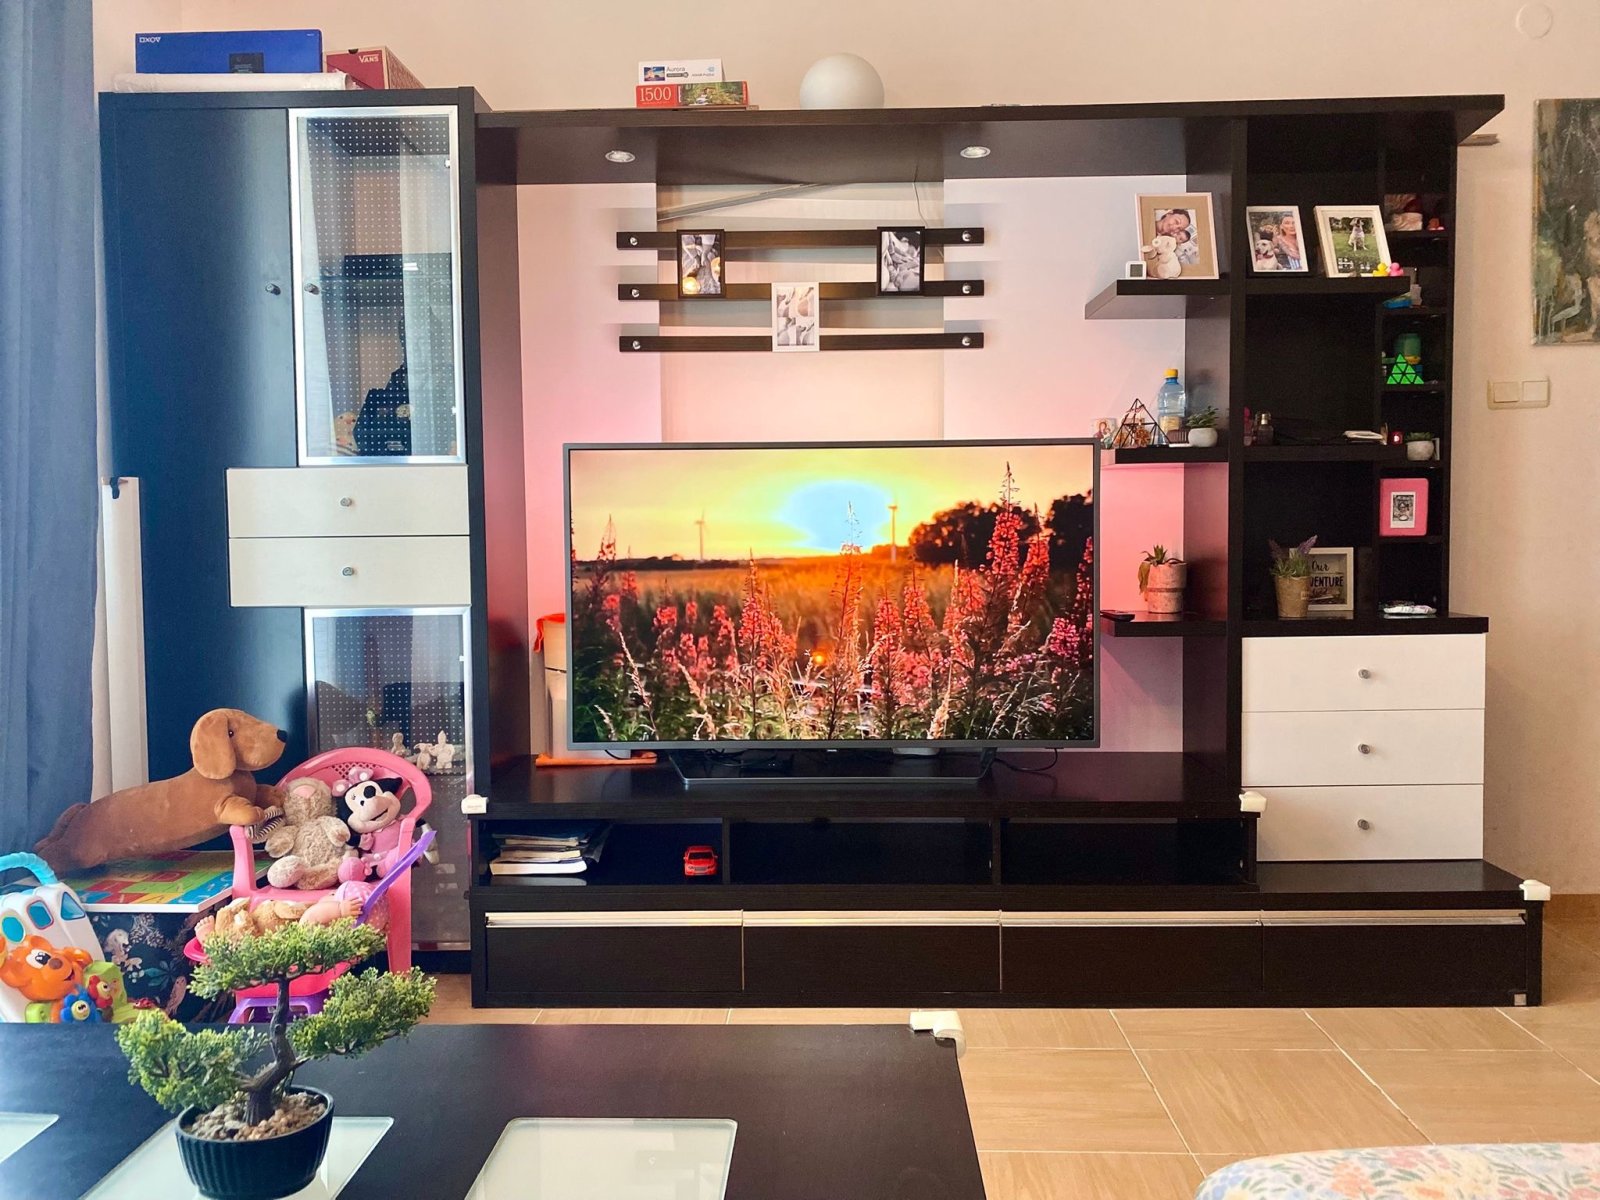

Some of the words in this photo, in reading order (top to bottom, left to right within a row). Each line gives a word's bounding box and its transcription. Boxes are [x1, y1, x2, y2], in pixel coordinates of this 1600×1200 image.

[359, 54, 379, 63] VANS
[640, 86, 672, 102] 1500
[1310, 576, 1344, 587] VENTURE
